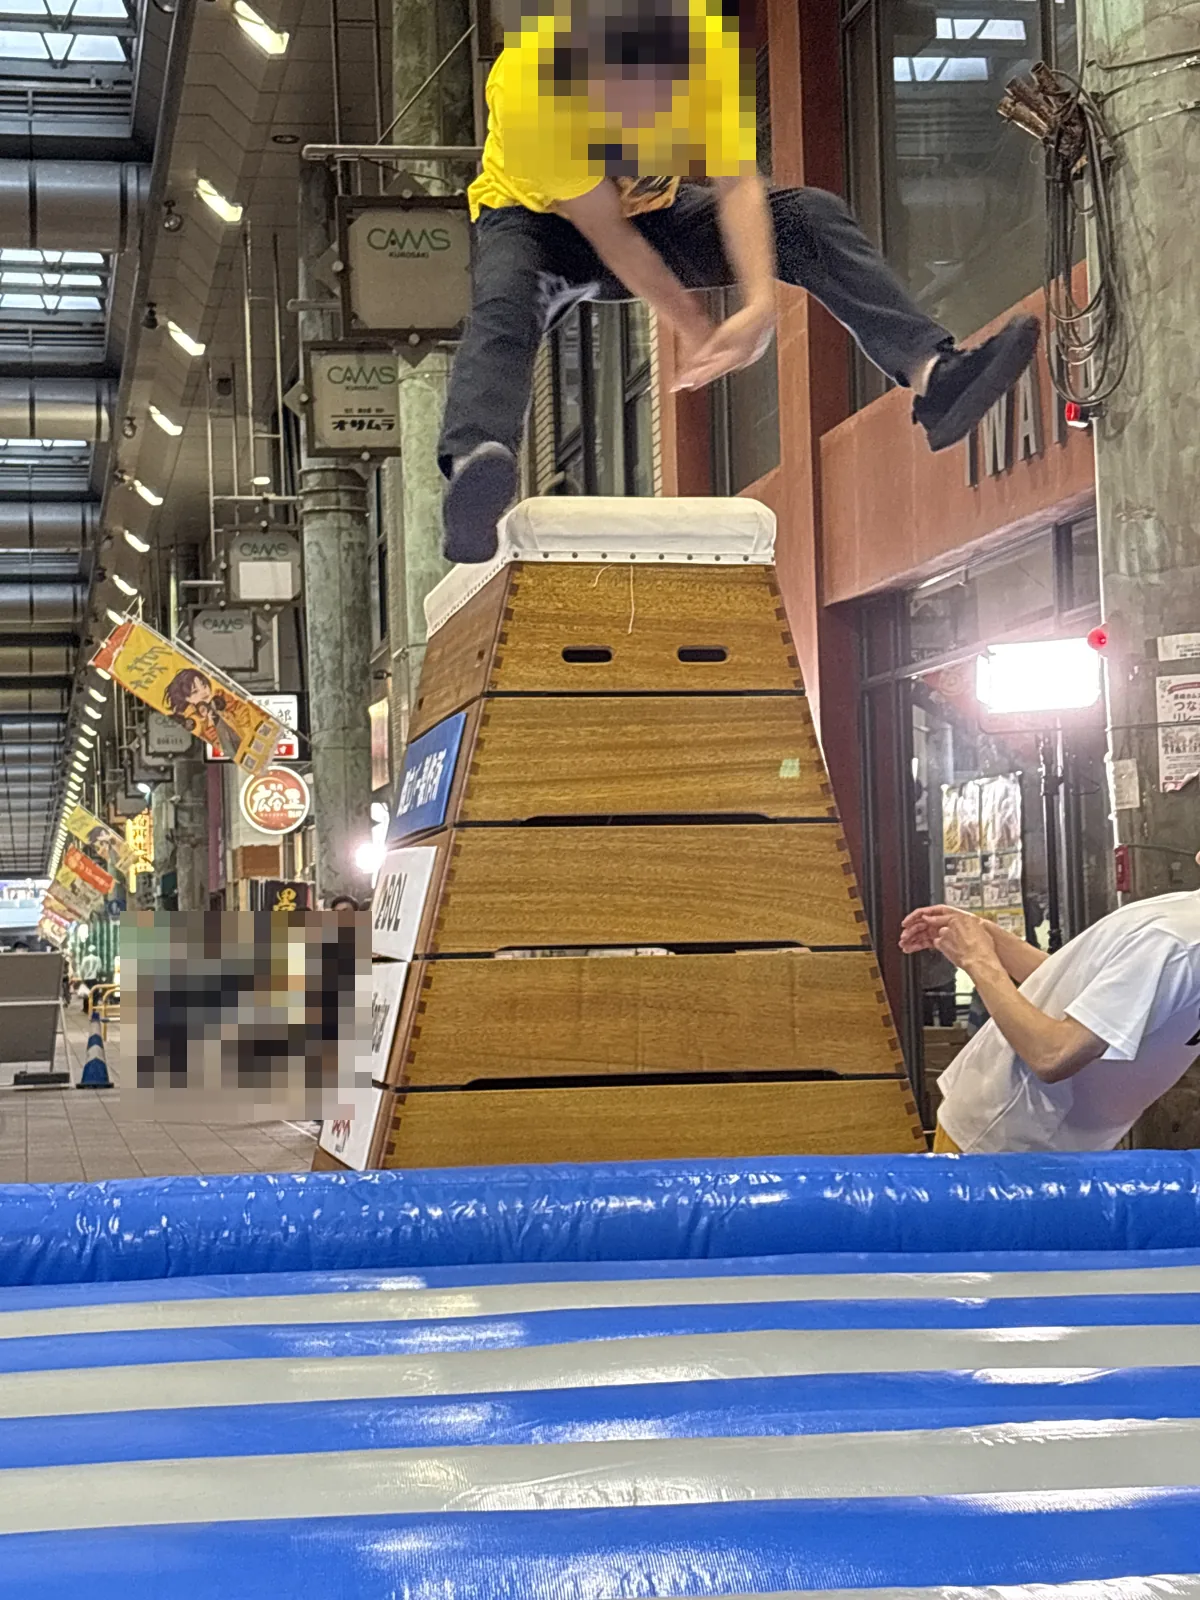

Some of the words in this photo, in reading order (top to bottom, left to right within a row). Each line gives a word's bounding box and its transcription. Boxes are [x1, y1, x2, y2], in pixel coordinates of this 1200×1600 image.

[366, 227, 451, 251] CAMS
[327, 366, 397, 385] CAMS
[239, 543, 289, 557] CAMS
[202, 618, 244, 630] CAMS
[1174, 701, 1200, 712] つな
